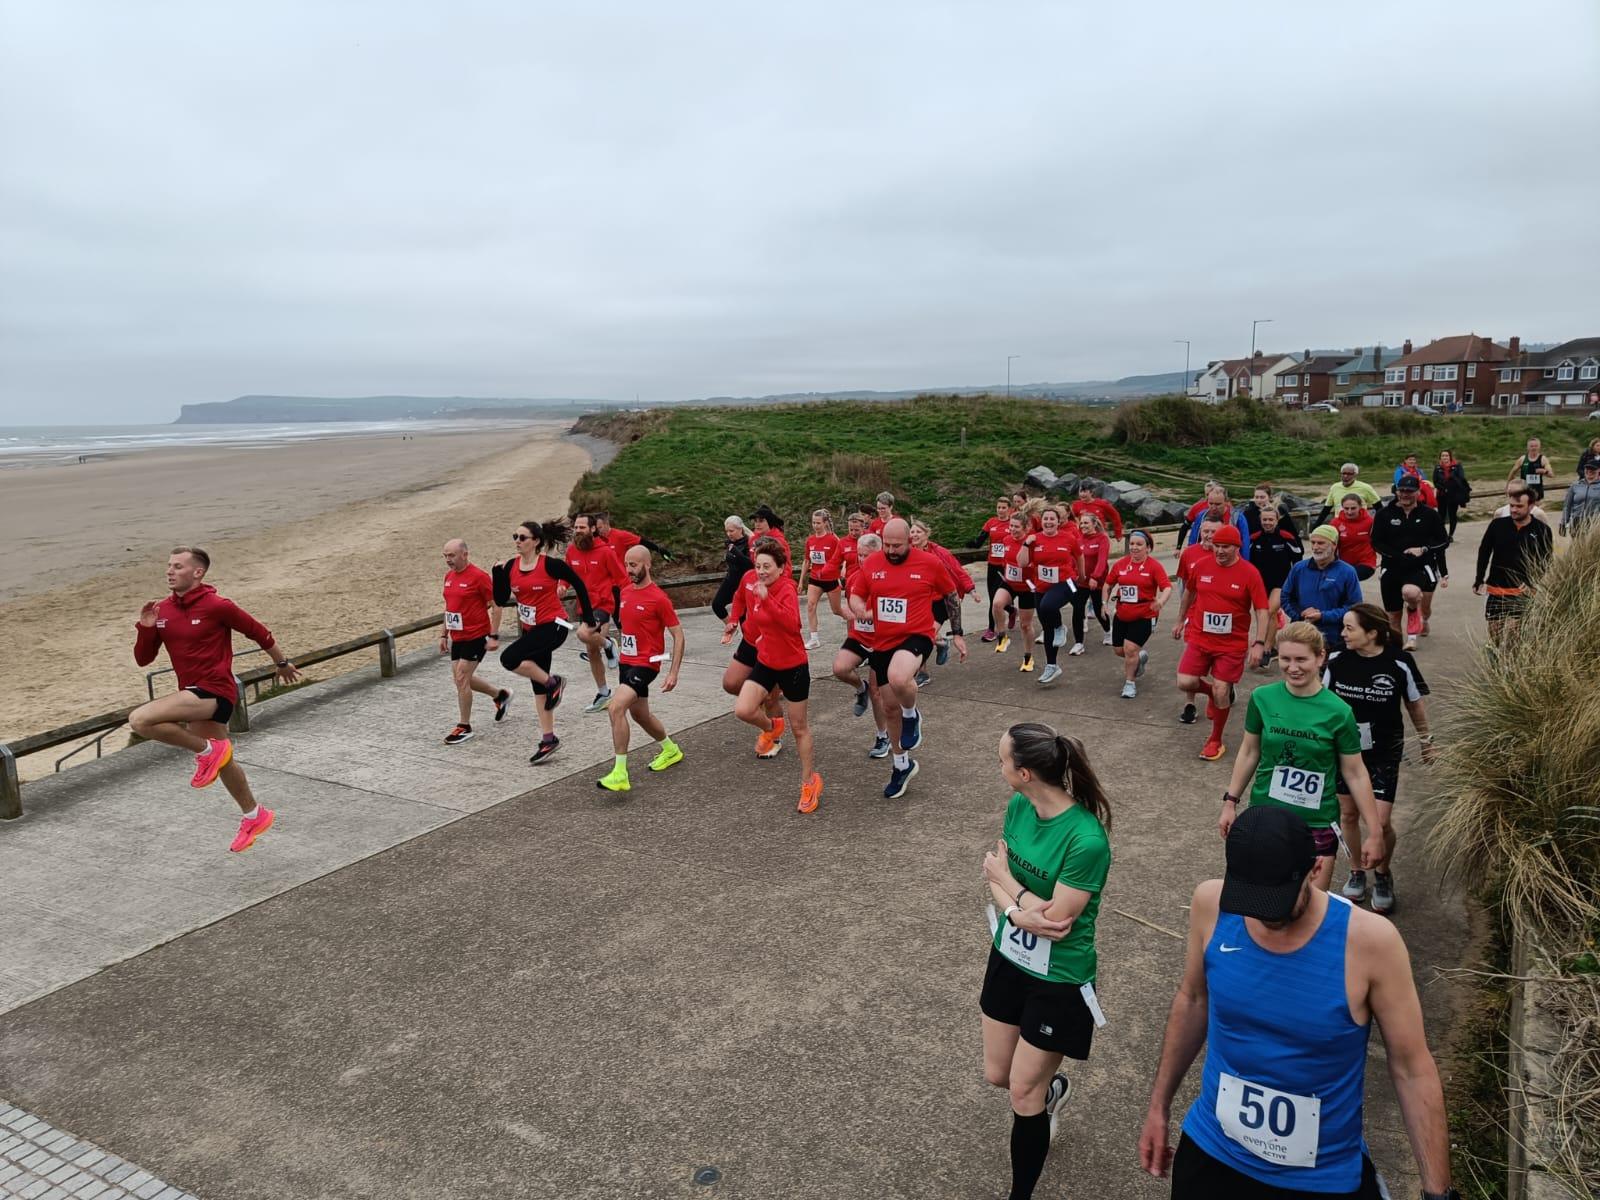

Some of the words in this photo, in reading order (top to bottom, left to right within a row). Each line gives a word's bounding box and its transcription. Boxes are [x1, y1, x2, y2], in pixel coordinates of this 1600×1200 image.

[1008, 566, 1018, 577] 75
[1042, 567, 1053, 578] 91
[879, 598, 903, 614] 135
[1205, 613, 1229, 627] 107
[1269, 726, 1320, 740] SWALEDALE
[1279, 767, 1320, 794] 126
[1238, 1084, 1296, 1137] 50
[1243, 1135, 1287, 1153] everyone
[1262, 1150, 1287, 1160] ACTIVE
